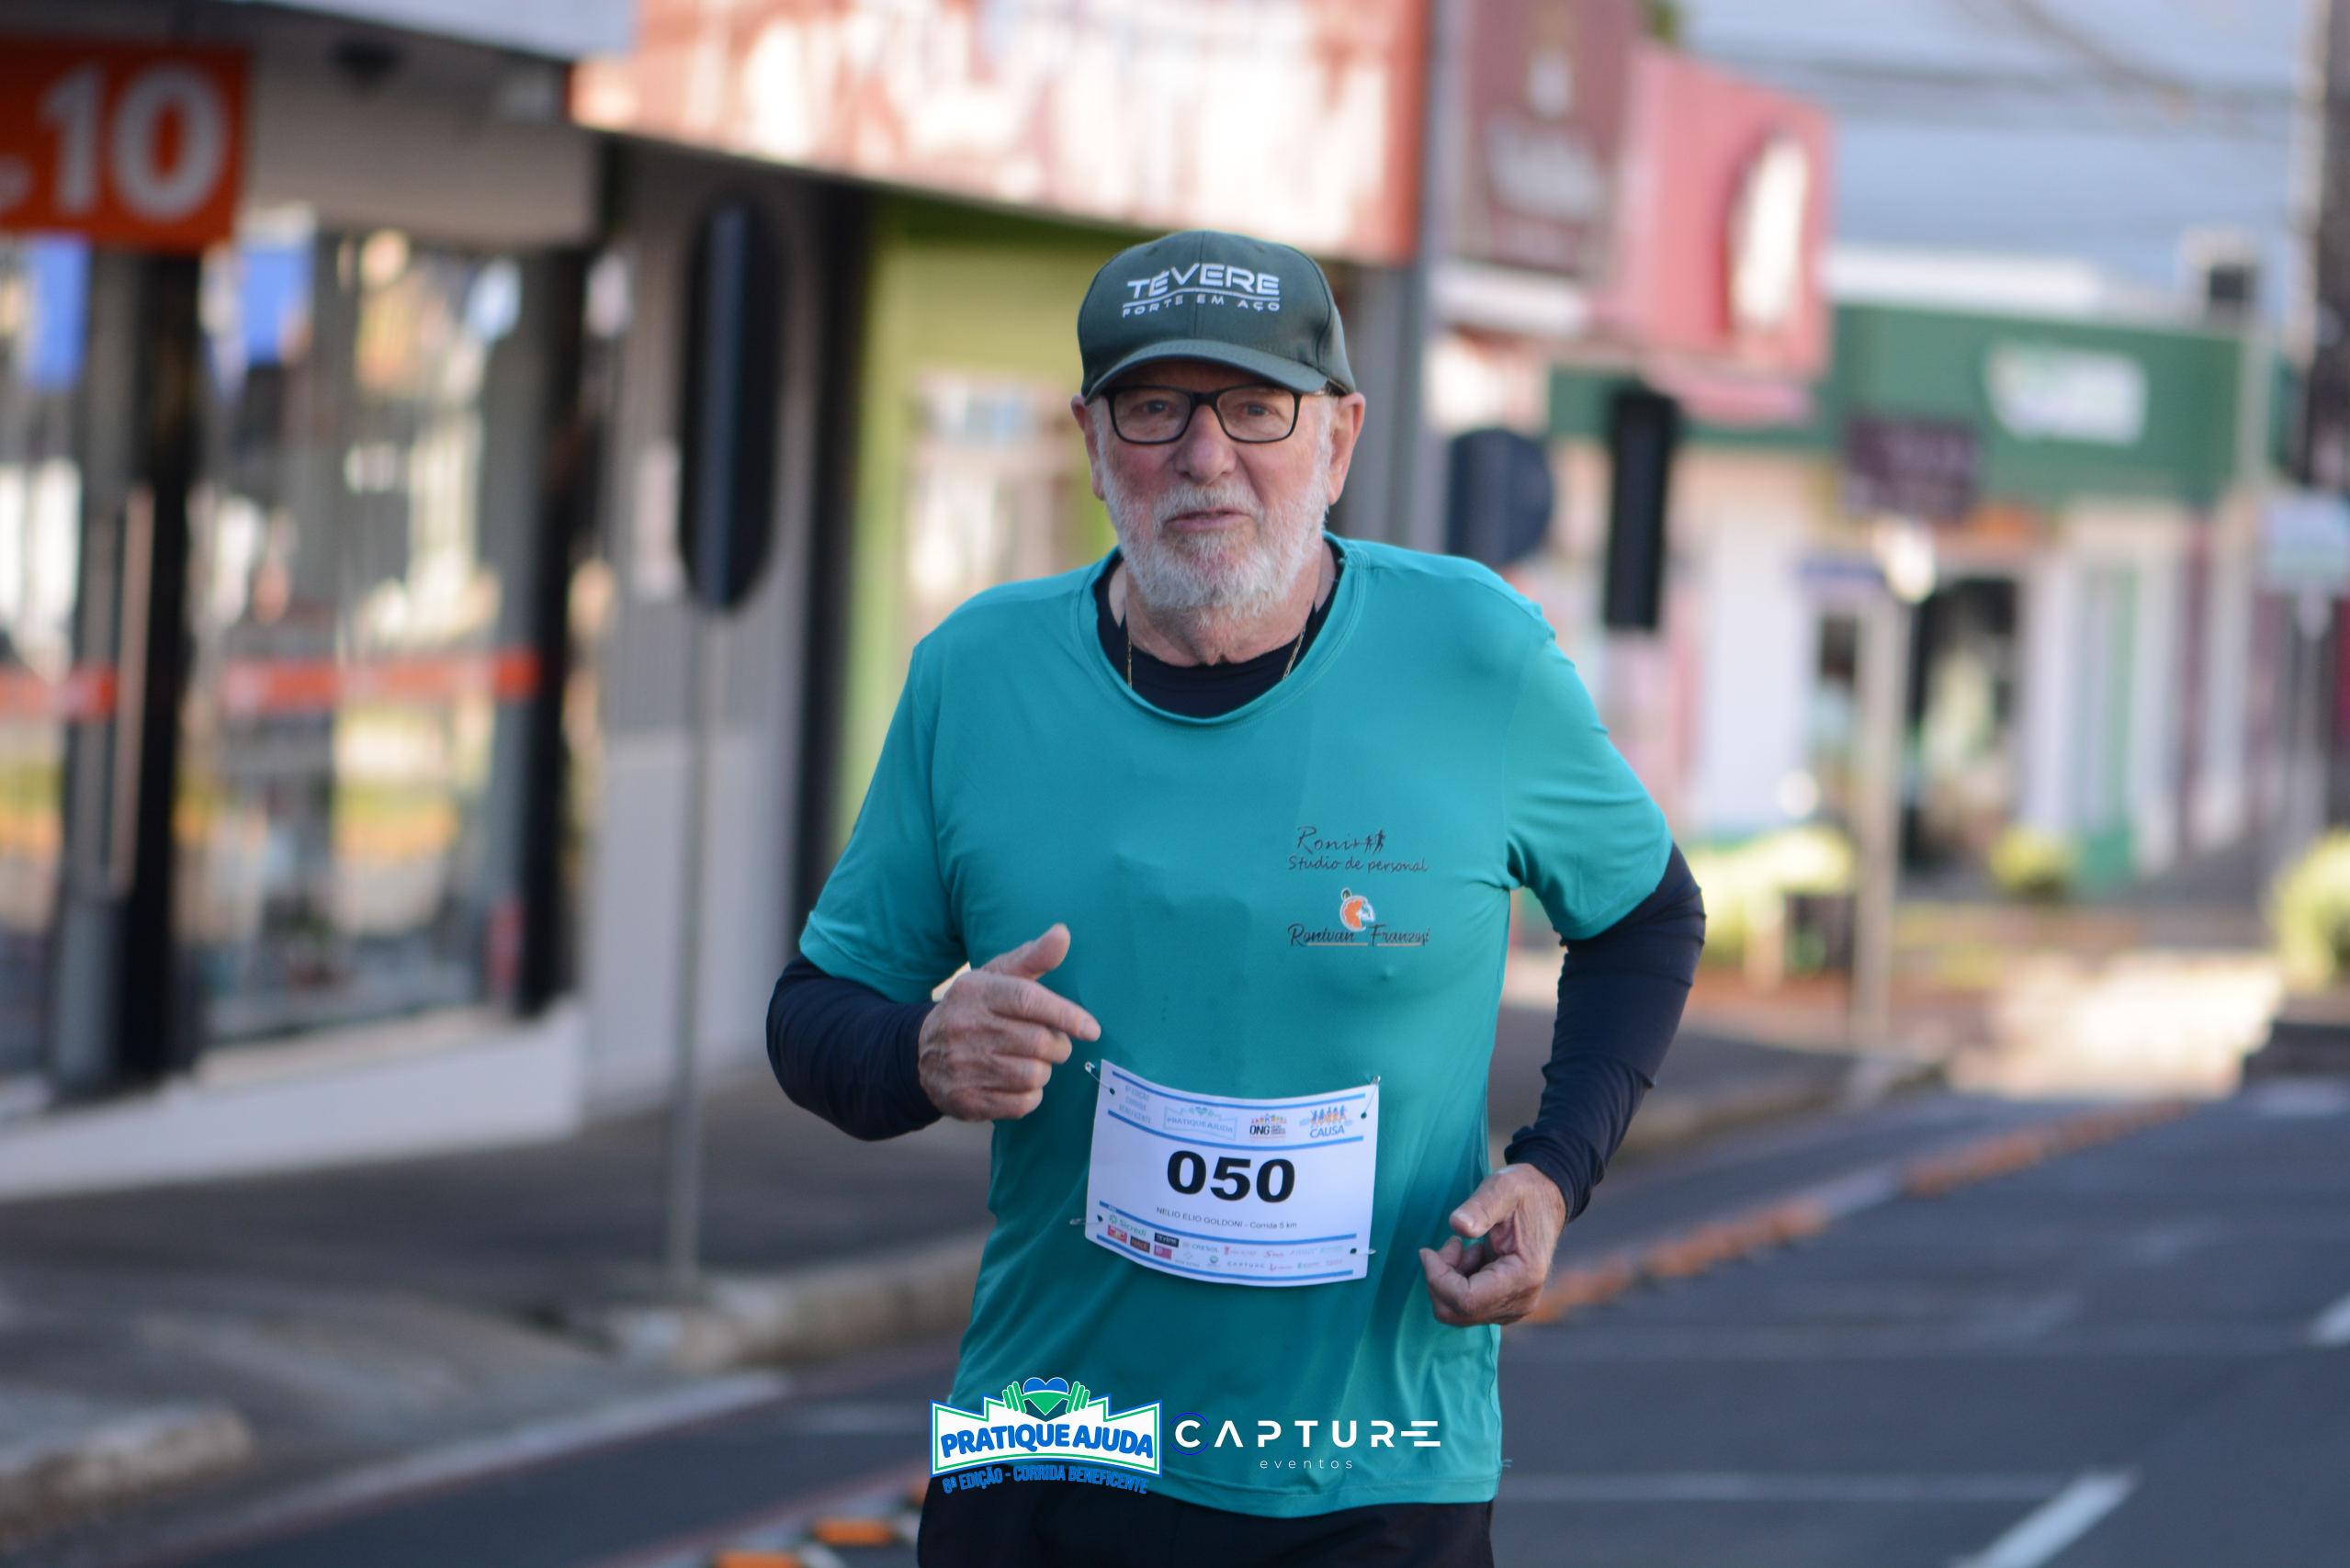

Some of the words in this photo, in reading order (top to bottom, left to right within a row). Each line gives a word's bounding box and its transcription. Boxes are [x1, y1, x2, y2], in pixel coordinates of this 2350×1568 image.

[39, 62, 228, 222] 10
[1123, 294, 1184, 318] FORTE
[1196, 293, 1225, 306] EM
[1237, 299, 1281, 312] AÇO
[1287, 854, 1342, 871] Studio
[1344, 855, 1364, 870] de
[1367, 857, 1429, 874] personal
[1287, 922, 1356, 947] Ronivan
[1167, 1116, 1206, 1129] PRATIQUE
[1206, 1122, 1234, 1134] AJUDA
[1249, 1124, 1270, 1135] ONG
[1309, 1124, 1345, 1139] CAUSA
[1167, 1150, 1295, 1203] 050
[1156, 1206, 1181, 1219] NELIO
[1182, 1213, 1202, 1223] ELIO
[1203, 1217, 1243, 1228] GOLDONI
[1119, 1219, 1147, 1237] Sicredi
[1192, 1243, 1219, 1253] CRESOL
